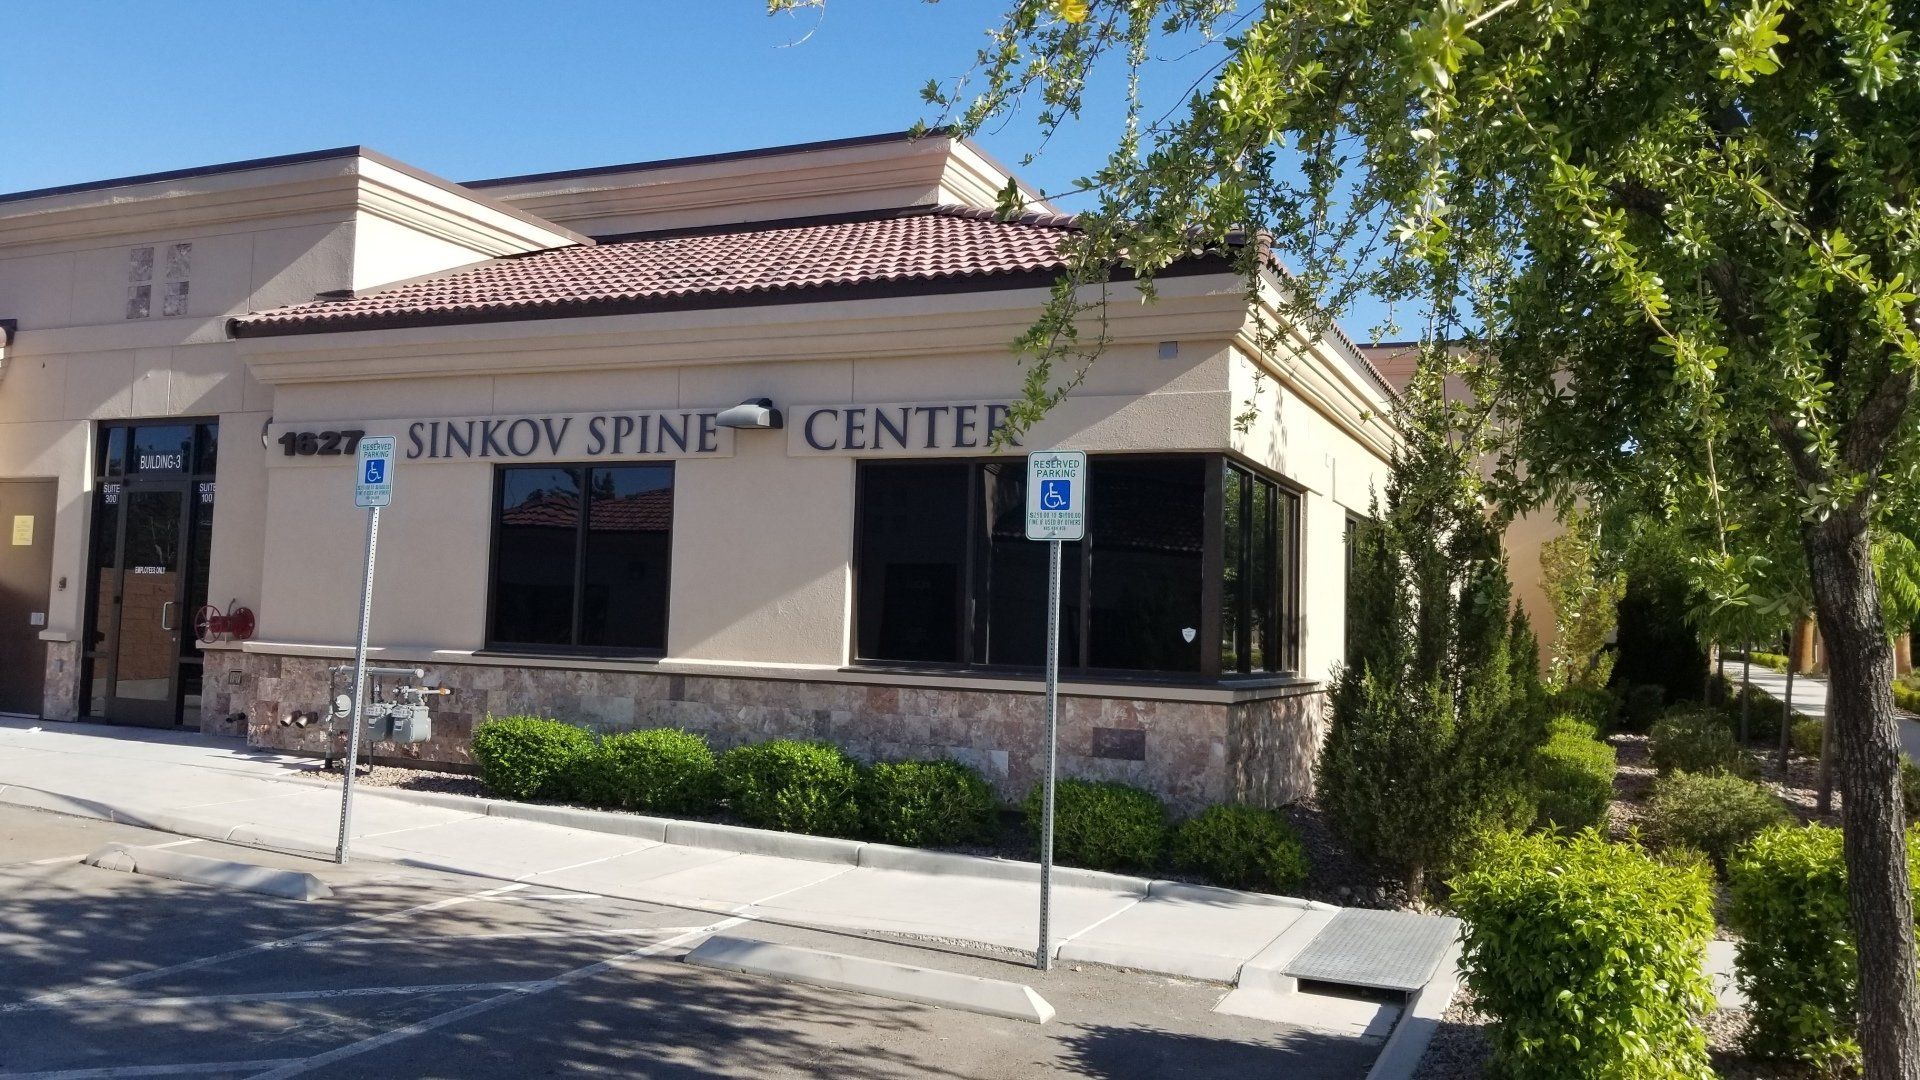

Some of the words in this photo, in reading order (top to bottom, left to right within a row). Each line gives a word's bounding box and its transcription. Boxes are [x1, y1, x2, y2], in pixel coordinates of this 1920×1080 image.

[406, 417, 573, 459] SINKOV
[587, 412, 718, 455] SPINE
[804, 404, 1024, 451] CENTER
[278, 430, 365, 456] 1627
[362, 443, 392, 451] RESERVED
[140, 454, 181, 469] BUILDING-3
[1033, 459, 1080, 469] RESERVED
[1036, 469, 1076, 478] PARKING
[103, 484, 121, 493] SUITE
[199, 482, 216, 492] SUITE
[105, 494, 117, 503] 300
[201, 493, 213, 503] 100
